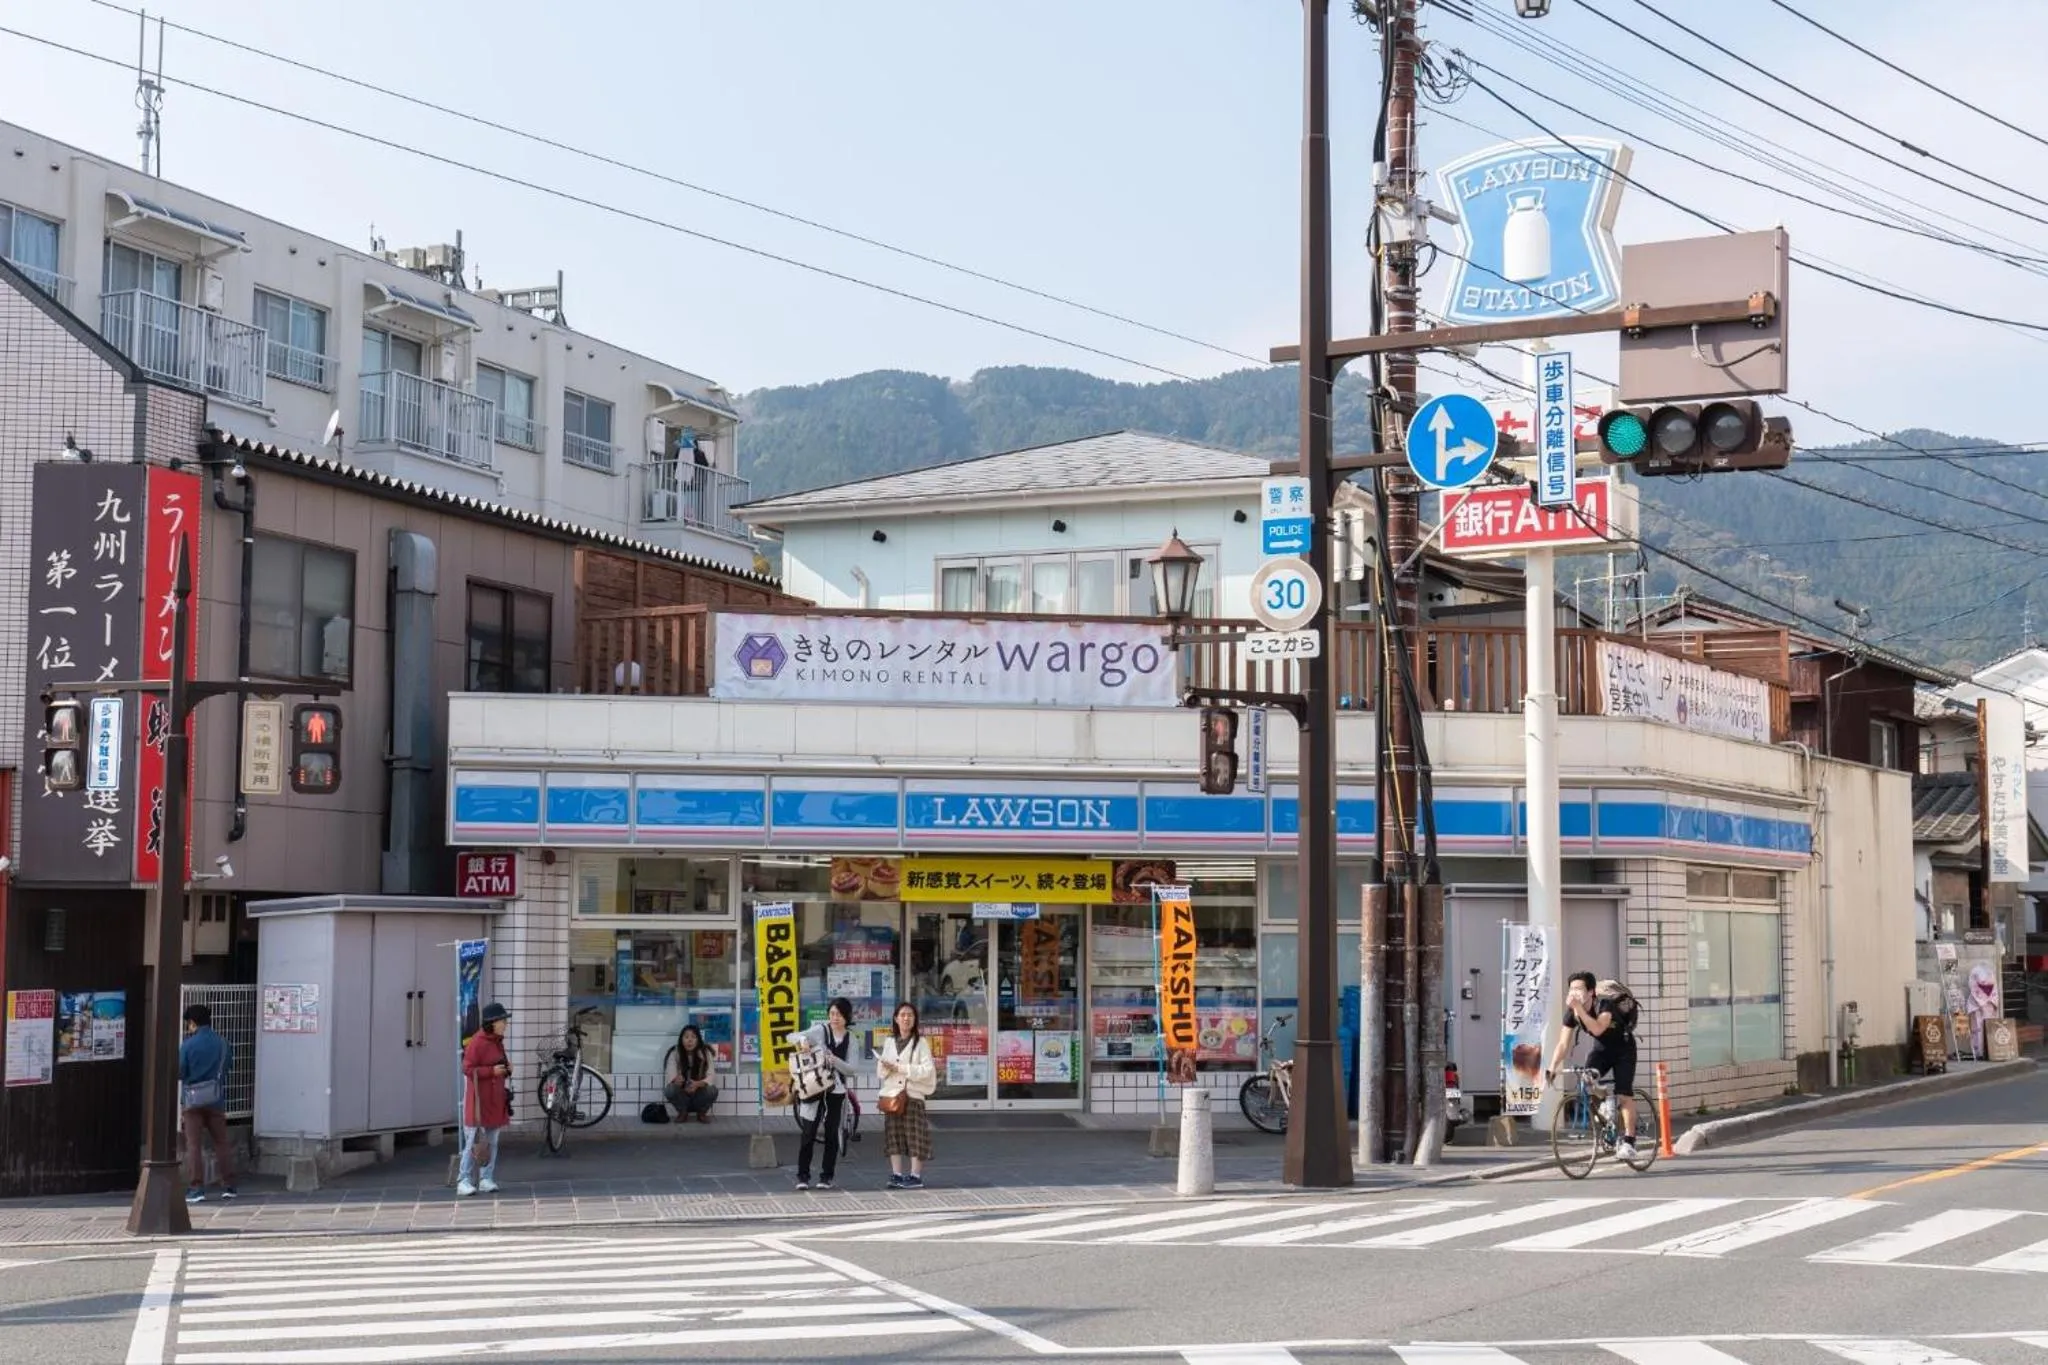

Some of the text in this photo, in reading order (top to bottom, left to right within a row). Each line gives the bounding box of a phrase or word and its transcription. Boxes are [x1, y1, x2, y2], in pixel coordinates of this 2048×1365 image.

[1459, 157, 1599, 200] LAWSON
[1463, 271, 1599, 311] STATION
[1544, 360, 1566, 496] 歩車分離信号
[1268, 486, 1304, 504] 警察
[1268, 524, 1304, 537] POLICE
[1266, 577, 1305, 610] 30
[1250, 635, 1315, 654] ここから
[83, 488, 132, 858] 九州ラーメ選挙
[793, 634, 1160, 688] きものレンタル wargo
[796, 668, 988, 686] KIMONO RENTAL
[932, 798, 1112, 829] LAWSON
[467, 857, 508, 874] 銀行
[906, 870, 1106, 891] 新感覚スイーツ、続々登場
[464, 875, 511, 894] ATM
[1511, 959, 1527, 1029] カフェラテ
[1529, 958, 1542, 1000] アイス
[1511, 1086, 1540, 1100] ¥150
